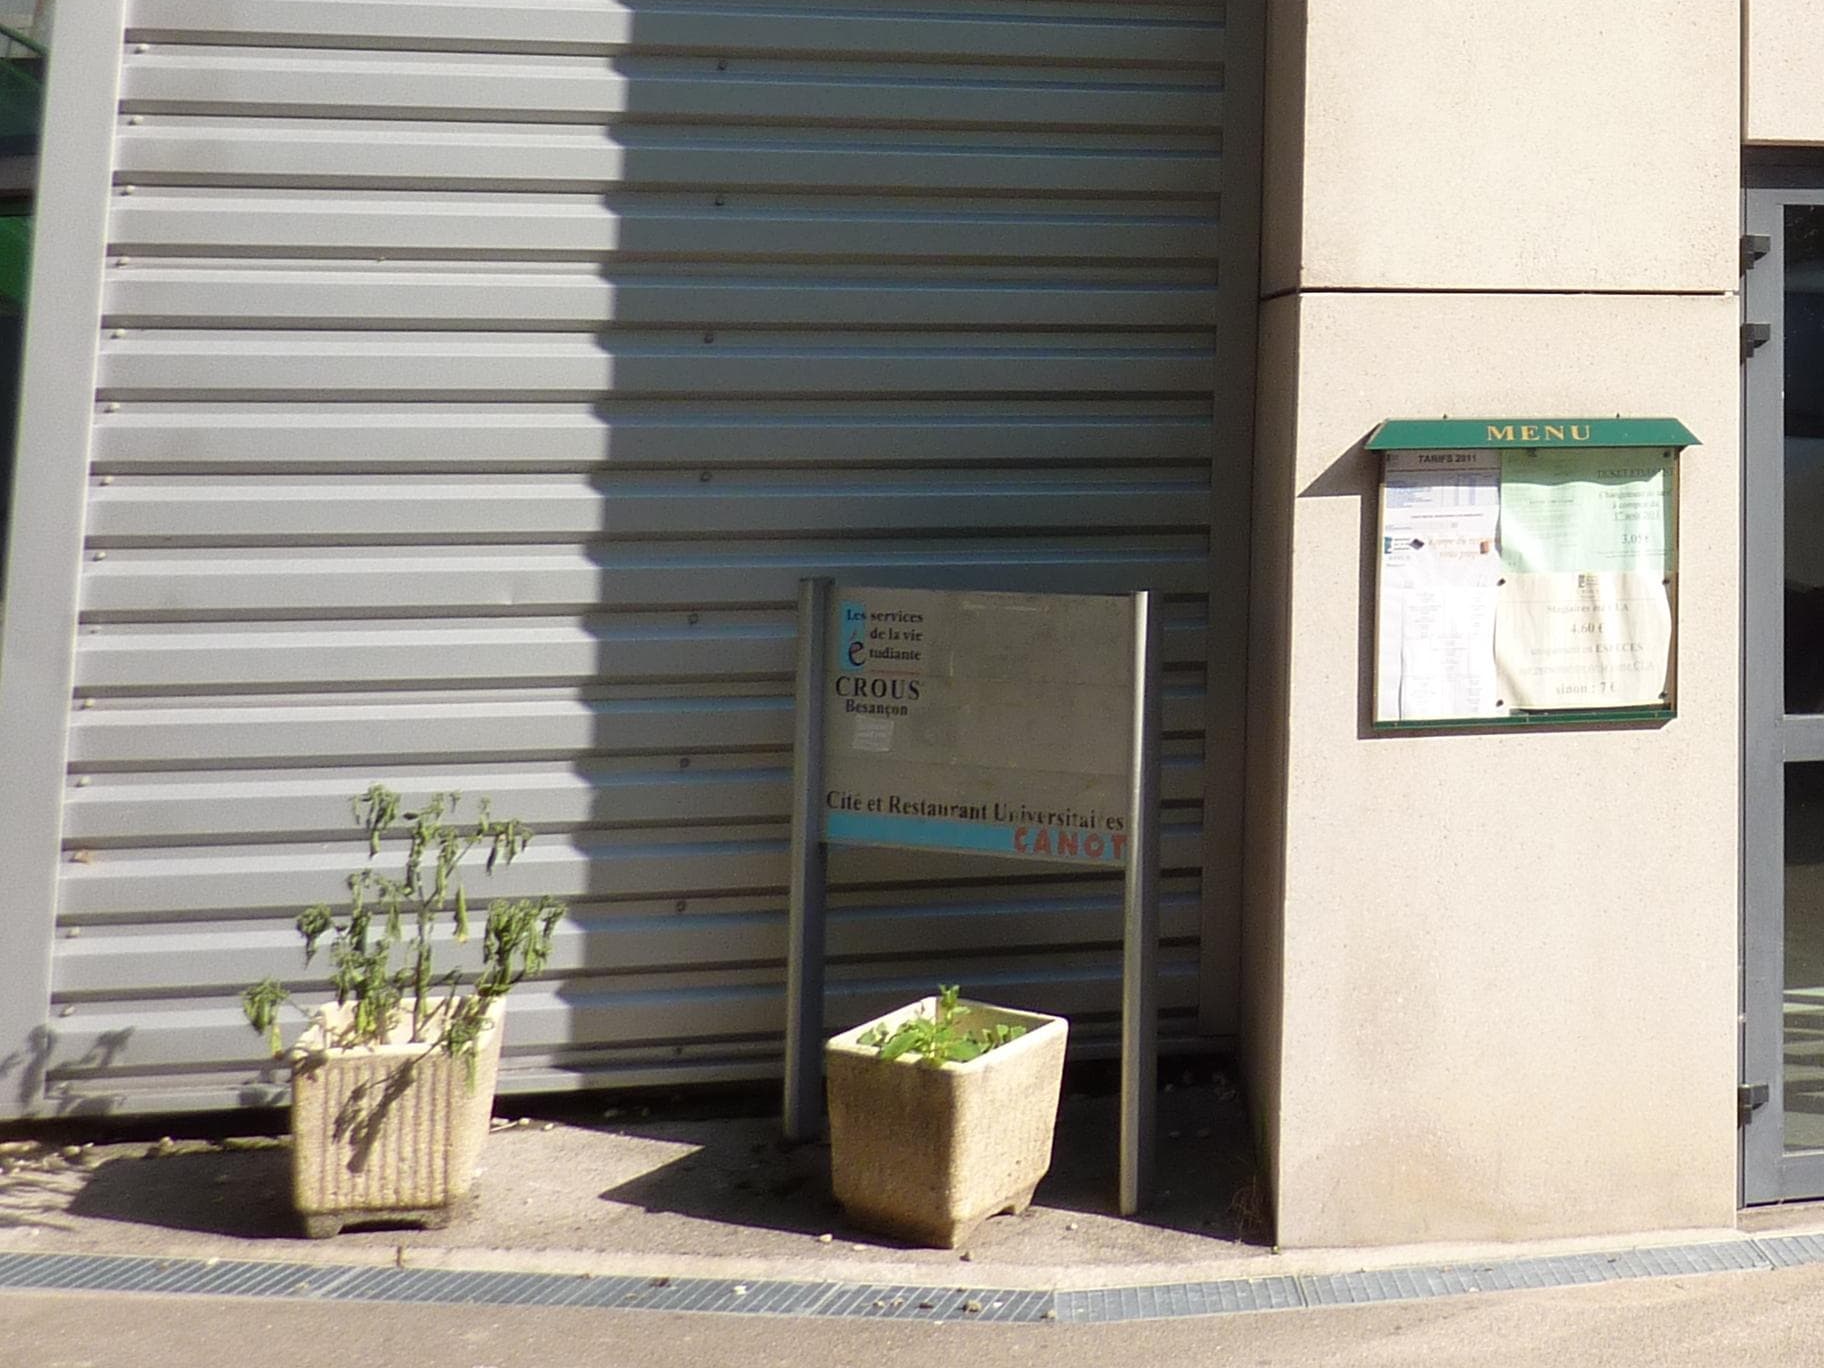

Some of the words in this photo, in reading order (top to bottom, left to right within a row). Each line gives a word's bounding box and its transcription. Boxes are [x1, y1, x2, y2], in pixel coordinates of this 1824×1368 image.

[1487, 425, 1590, 441] MENU
[1418, 454, 1453, 463] TARIFS
[1455, 454, 1477, 463] 2011
[847, 609, 866, 621] Les
[871, 610, 924, 624] services
[870, 628, 886, 640] de
[889, 628, 901, 641] la
[904, 629, 924, 642] vie
[835, 675, 921, 701] CROUS
[846, 699, 909, 718] Besançon
[826, 790, 862, 811] Cité
[867, 795, 882, 812] et
[889, 795, 987, 820] Restaurant
[993, 802, 1125, 831] Universitaies
[1014, 826, 1128, 859] CANOT
